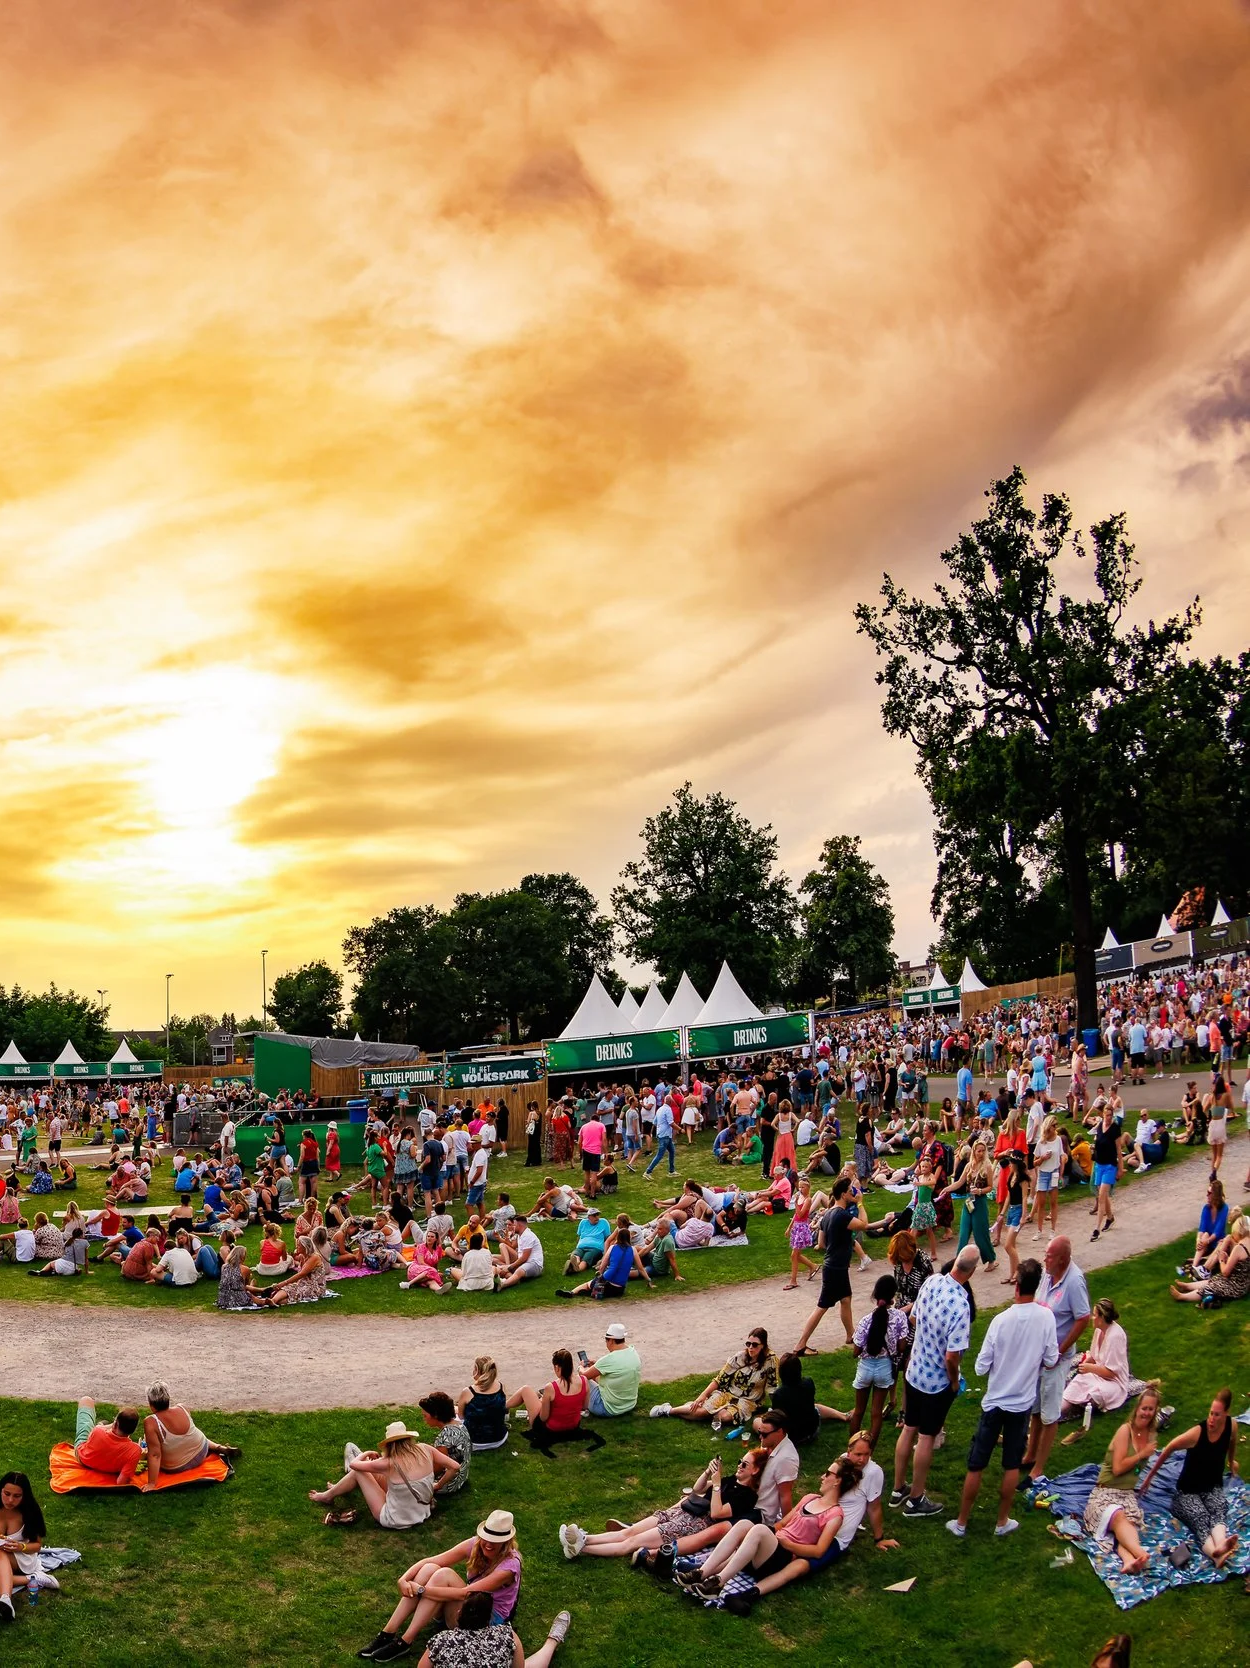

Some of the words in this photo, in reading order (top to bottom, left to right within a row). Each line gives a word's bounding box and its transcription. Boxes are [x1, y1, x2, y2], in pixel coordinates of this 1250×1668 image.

[733, 1027, 767, 1047] DRINKS
[595, 1042, 633, 1062] DRINKS
[461, 1069, 530, 1083] VOLKSPARK
[468, 1066, 476, 1074] IN
[479, 1065, 491, 1073] HET
[371, 1070, 435, 1085] ROLSTOELPODIUM
